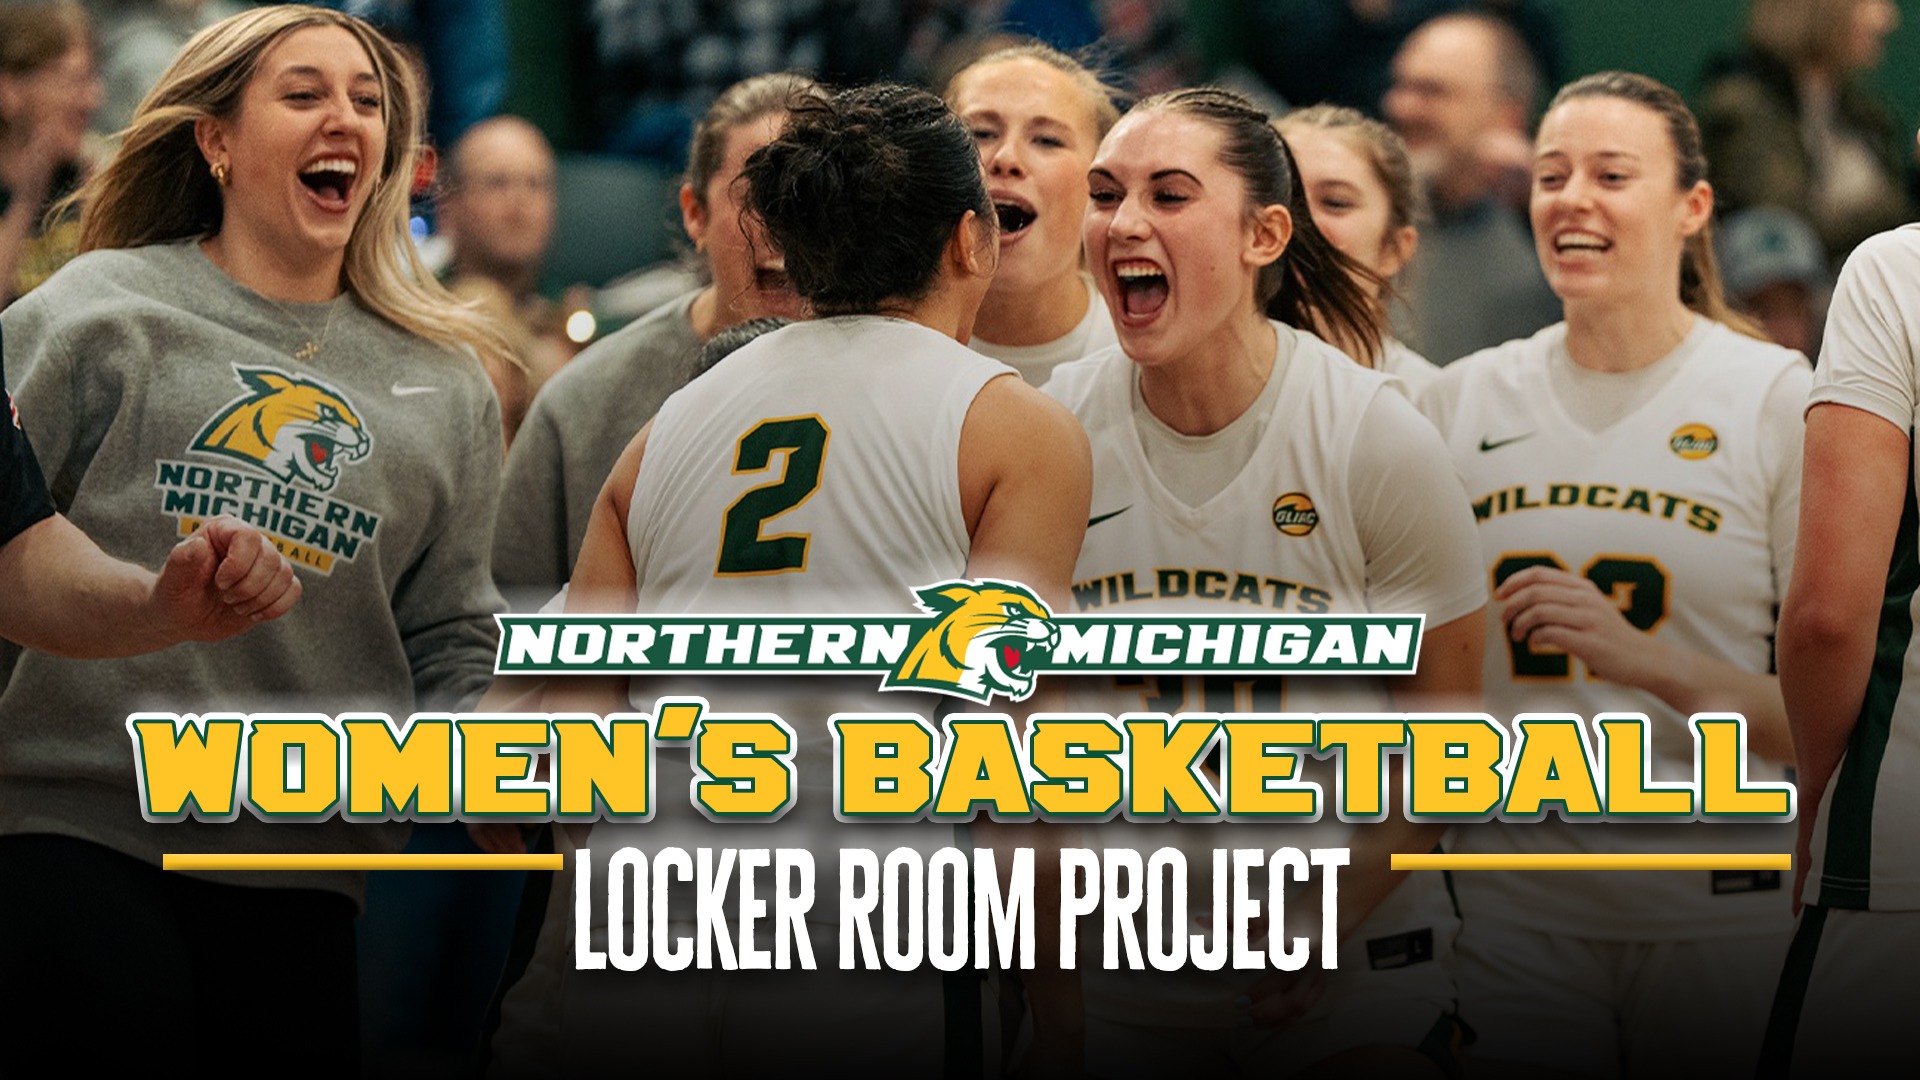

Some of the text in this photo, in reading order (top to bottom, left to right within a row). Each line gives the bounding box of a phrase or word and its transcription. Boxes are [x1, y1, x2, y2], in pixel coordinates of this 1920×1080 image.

[158, 463, 378, 538] NORTHERN
[164, 490, 360, 559] MICHIGAN
[714, 413, 832, 578] 2
[1071, 567, 1334, 614] WILDCATS
